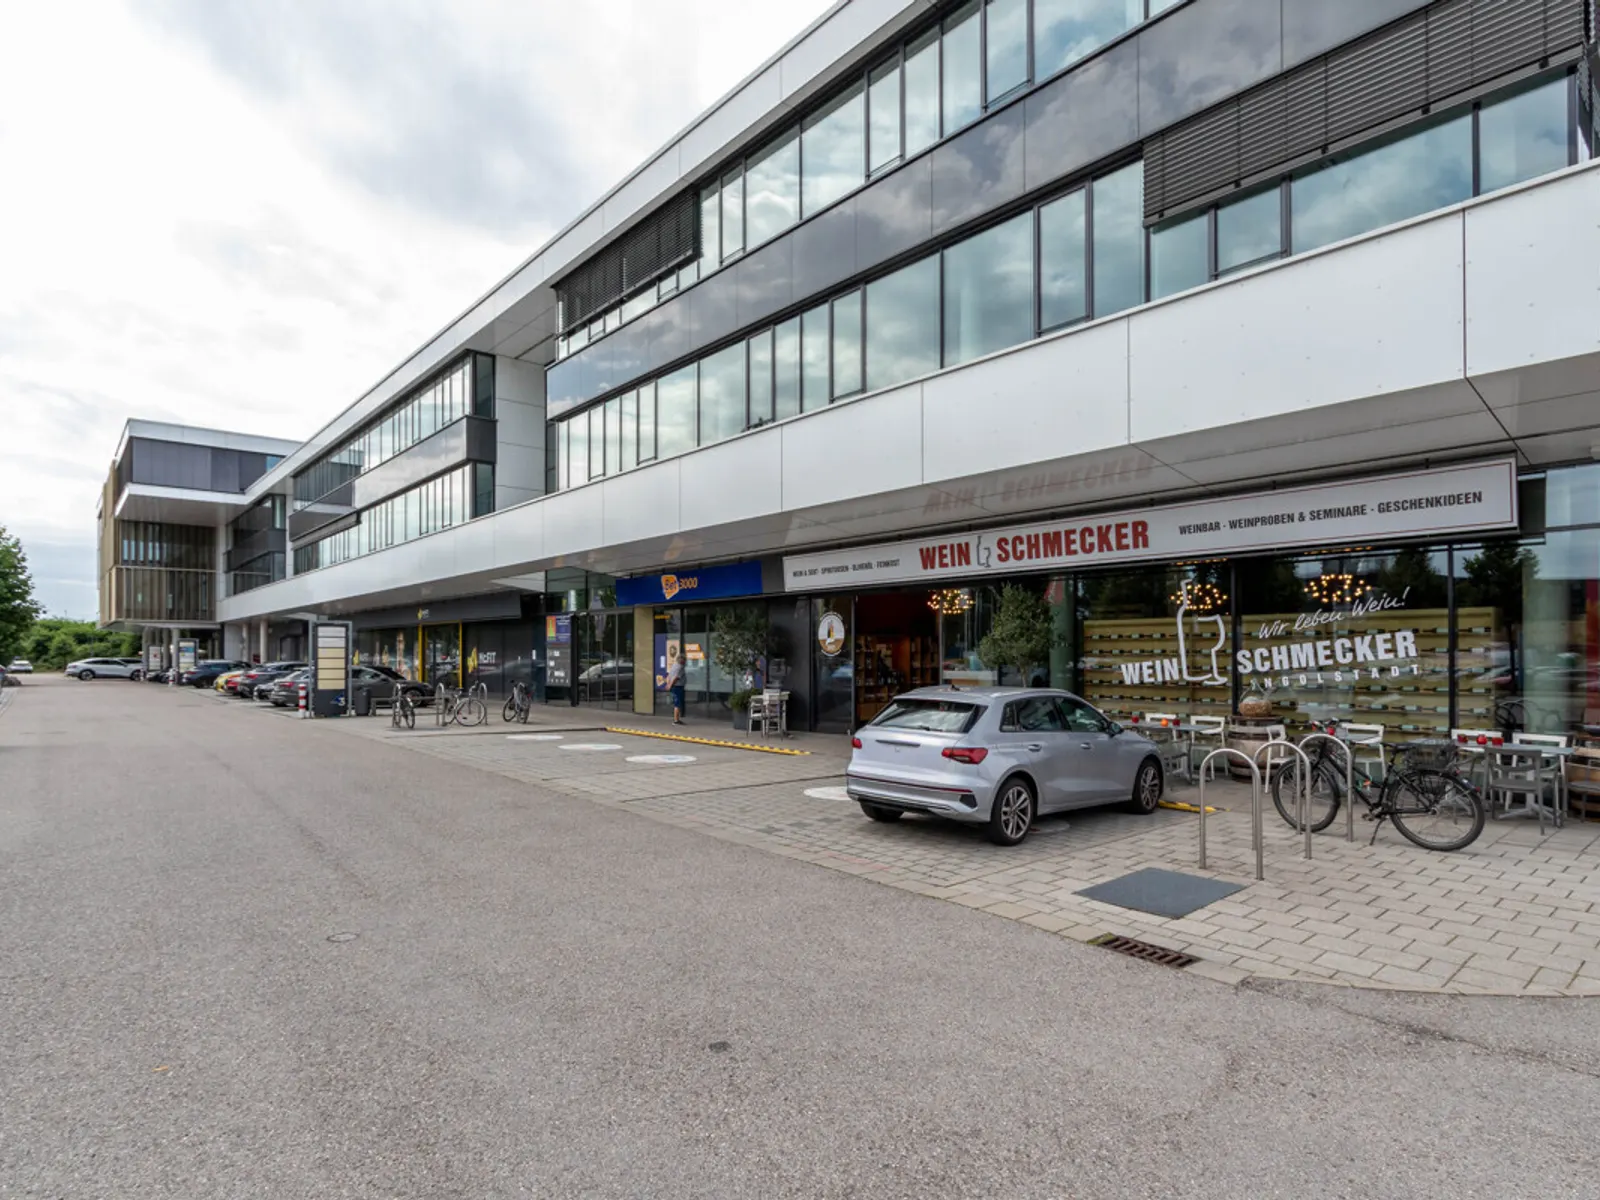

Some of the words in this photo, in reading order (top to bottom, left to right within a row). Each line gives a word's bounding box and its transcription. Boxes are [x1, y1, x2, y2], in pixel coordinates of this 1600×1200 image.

[1178, 521, 1221, 535] WEINBAR
[1228, 512, 1295, 530] WEINPROBEN
[1298, 511, 1306, 522] &
[1309, 504, 1367, 521] SEMINARE
[1377, 490, 1483, 514] GESCHENKIDEEN
[918, 541, 971, 570] WEIN
[996, 519, 1150, 563] SCHMECKER
[1258, 619, 1290, 639] Wir
[1294, 608, 1345, 631] leben
[1352, 586, 1411, 617] Wein!
[1121, 658, 1179, 685] WEIN
[1236, 630, 1418, 674] SCHMECKER
